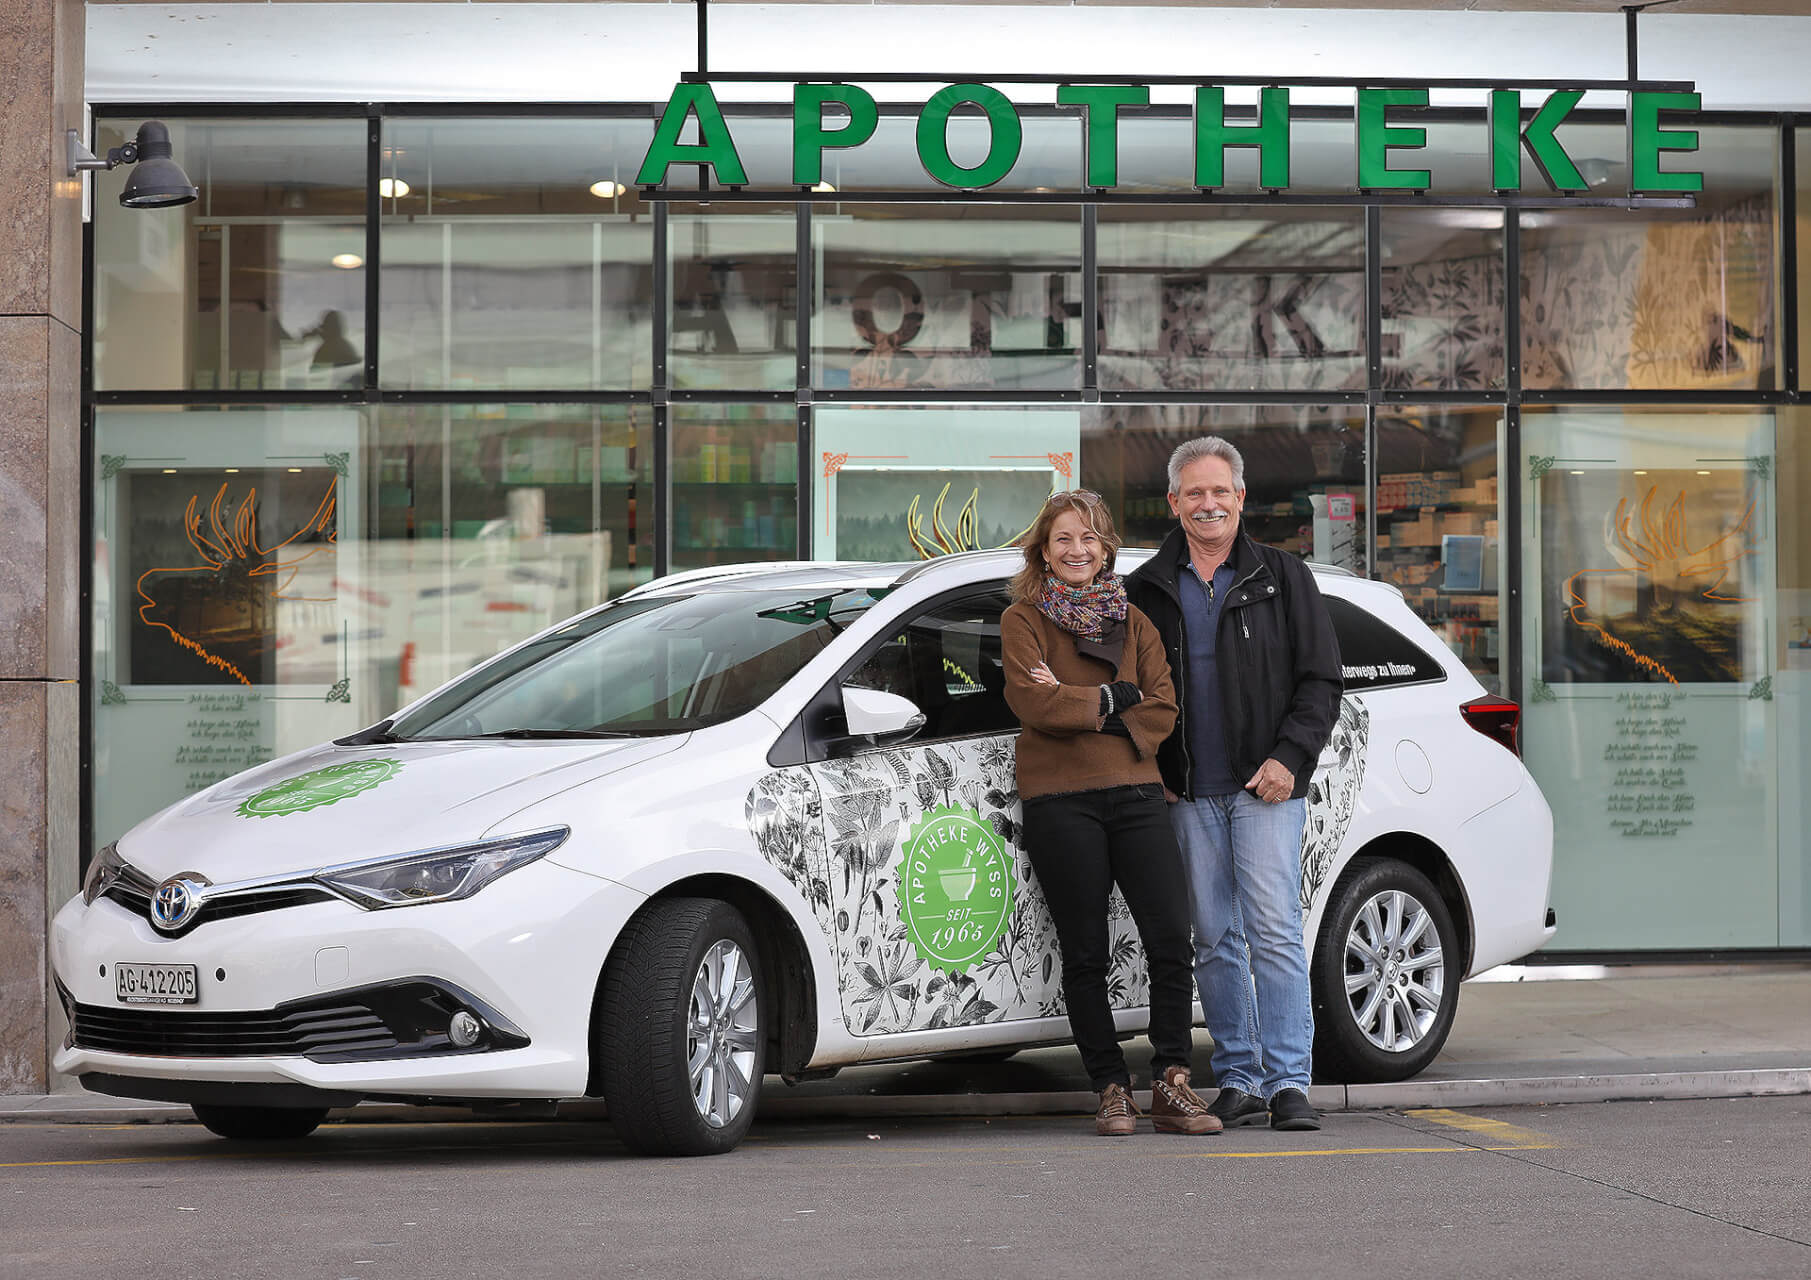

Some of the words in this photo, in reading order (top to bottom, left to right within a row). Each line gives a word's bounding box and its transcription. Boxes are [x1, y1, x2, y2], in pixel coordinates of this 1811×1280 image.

[633, 82, 1704, 192] APOTHEKE
[1377, 665, 1390, 676] zu
[912, 825, 969, 905] APOTHEKE
[975, 837, 1002, 899] WYSS
[945, 907, 972, 922] SEIT
[930, 920, 985, 951] 1965
